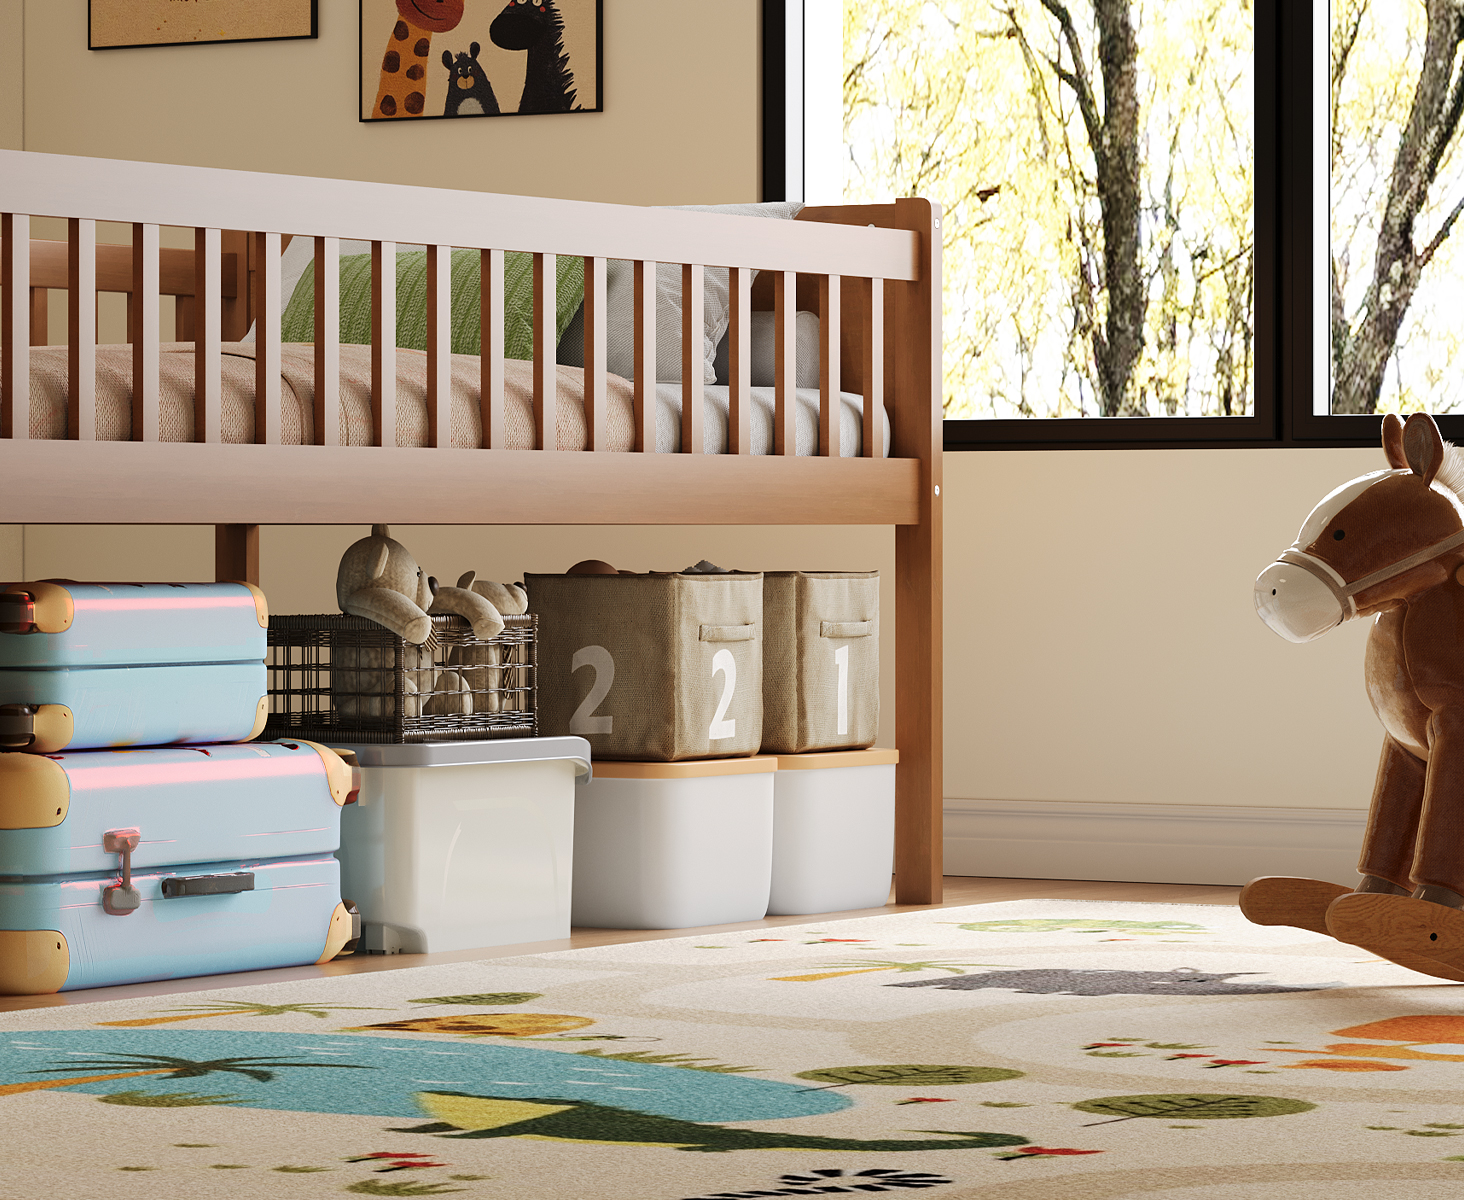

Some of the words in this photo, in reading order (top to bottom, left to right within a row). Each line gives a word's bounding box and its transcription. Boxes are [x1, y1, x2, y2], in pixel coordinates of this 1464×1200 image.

[569, 645, 615, 735] 2
[709, 649, 736, 740] 2
[834, 645, 849, 735] 1
